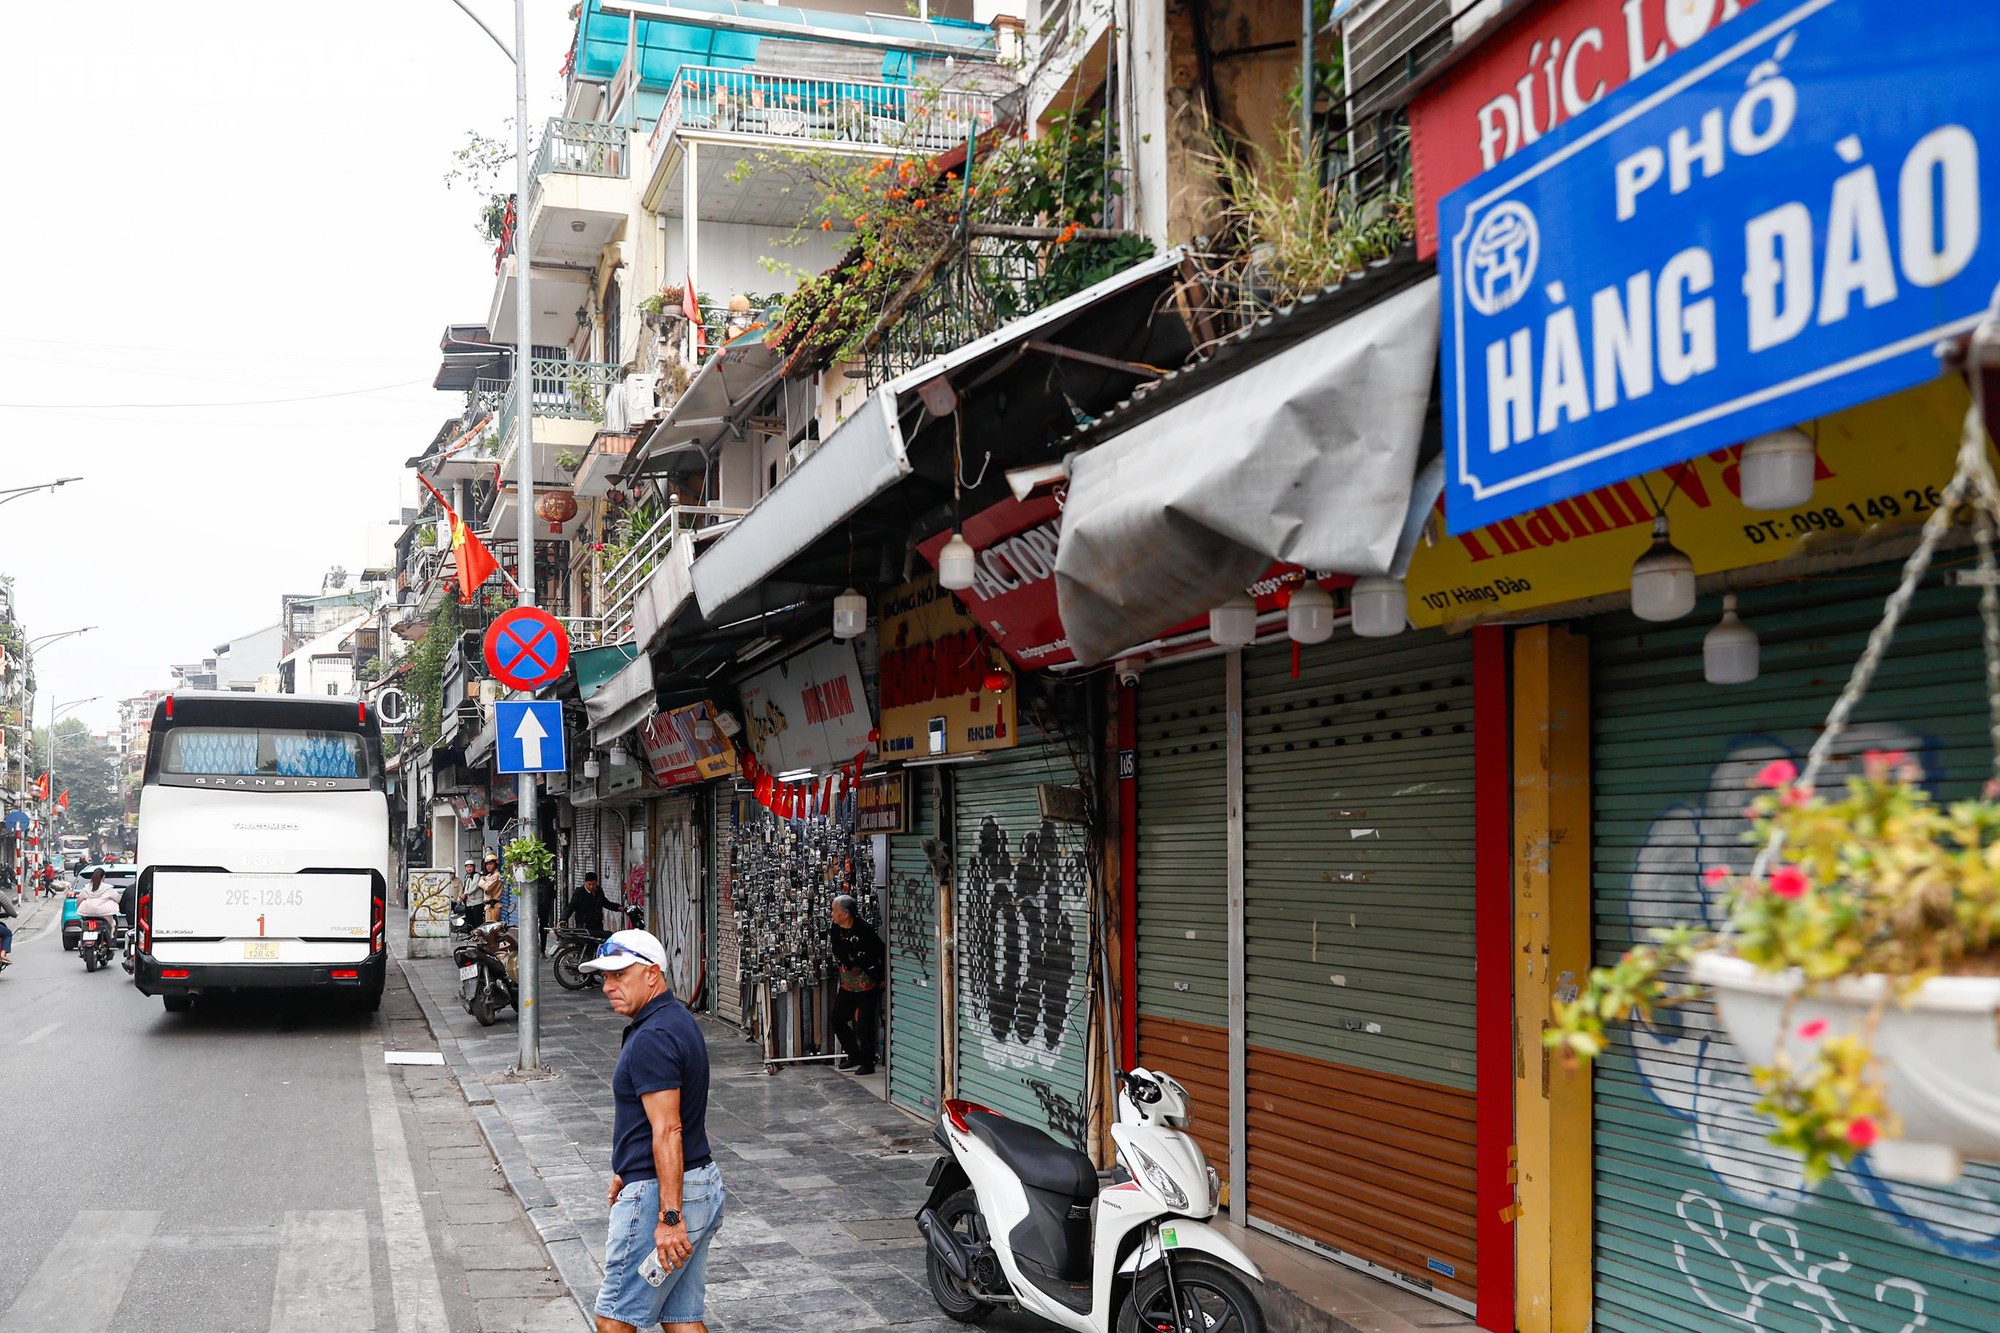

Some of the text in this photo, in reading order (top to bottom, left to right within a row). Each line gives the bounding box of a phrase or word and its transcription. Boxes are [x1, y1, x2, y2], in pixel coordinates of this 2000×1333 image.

[1477, 0, 1740, 171] ĐỨC LO
[1616, 31, 1797, 222] PHỐ
[1486, 124, 1981, 454] HÀNG ĐÀO
[1743, 519, 1792, 545] ĐT:
[1846, 494, 1901, 523] 149
[971, 519, 1062, 601] ACTORY
[1421, 576, 1532, 610] 107 Hàng Đào
[1120, 754, 1133, 776] 105
[194, 777, 338, 787] GRANBIRD
[242, 855, 286, 866] KIA
[256, 916, 265, 937] 1
[254, 942, 270, 951] 29E
[1102, 1199, 1122, 1210] HONDA
